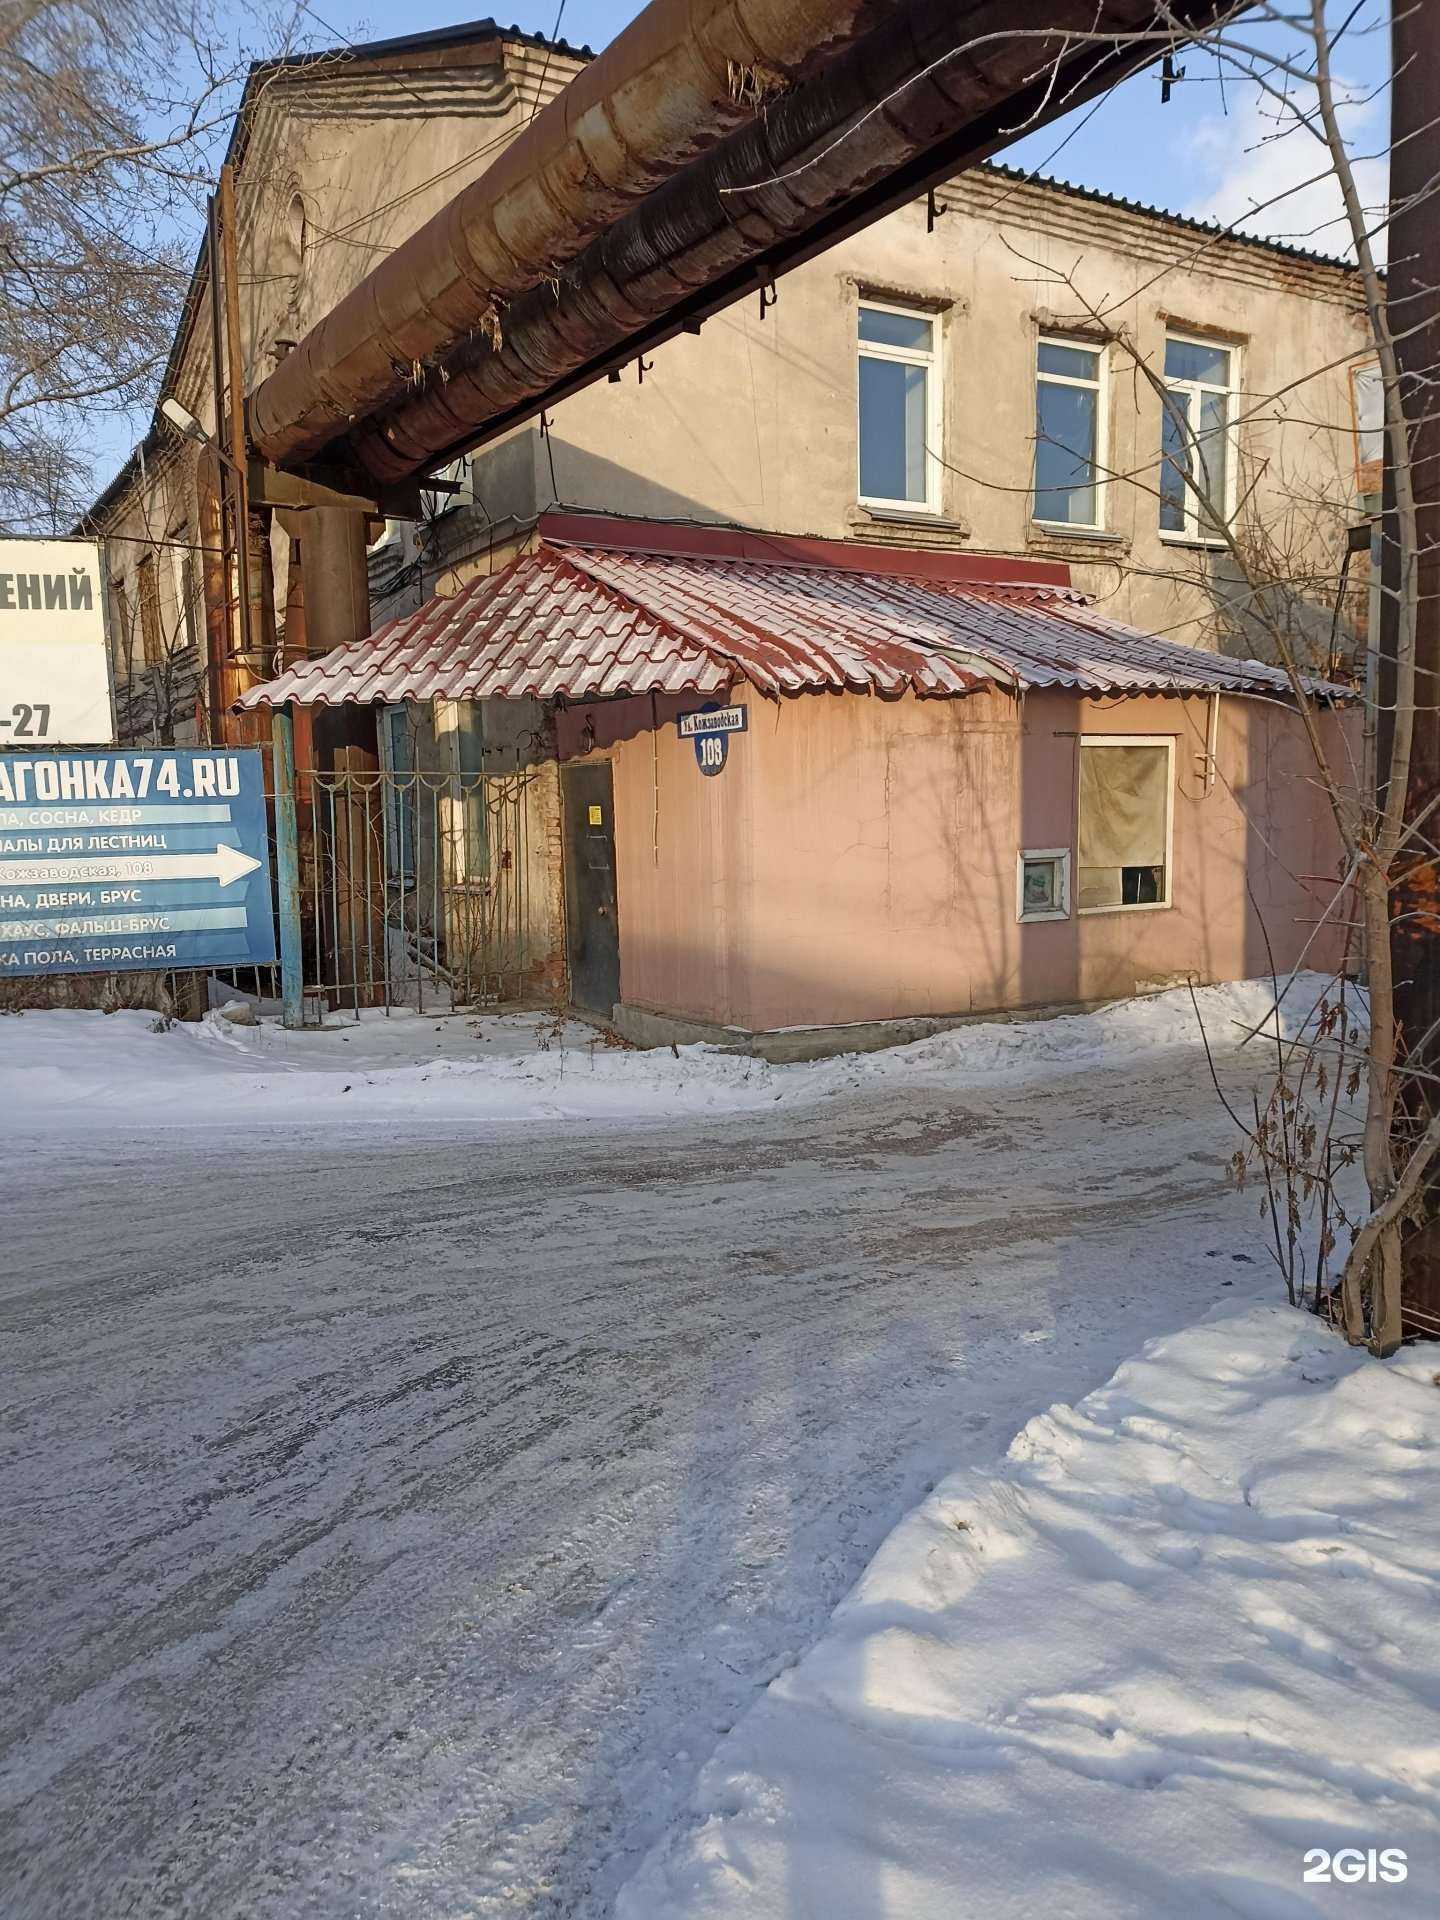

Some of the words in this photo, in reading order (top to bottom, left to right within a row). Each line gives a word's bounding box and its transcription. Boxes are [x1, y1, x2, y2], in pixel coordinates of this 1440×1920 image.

[700, 738, 723, 766] 108
[29, 811, 94, 827] СОСНА,
[99, 809, 142, 825] КЕДР
[0, 837, 42, 852] АЛЫ
[47, 836, 84, 853] ДЛЯ
[88, 834, 167, 850] ЛЕСТНИЦ
[125, 862, 152, 875] 108
[36, 891, 96, 909] ДВЕРИ,
[101, 889, 142, 904] БРУС
[55, 917, 170, 935] ФАЛЬШ-БРУС
[24, 949, 79, 966] ПОЛА,
[84, 944, 177, 962] ТЕРРАСНАЯ
